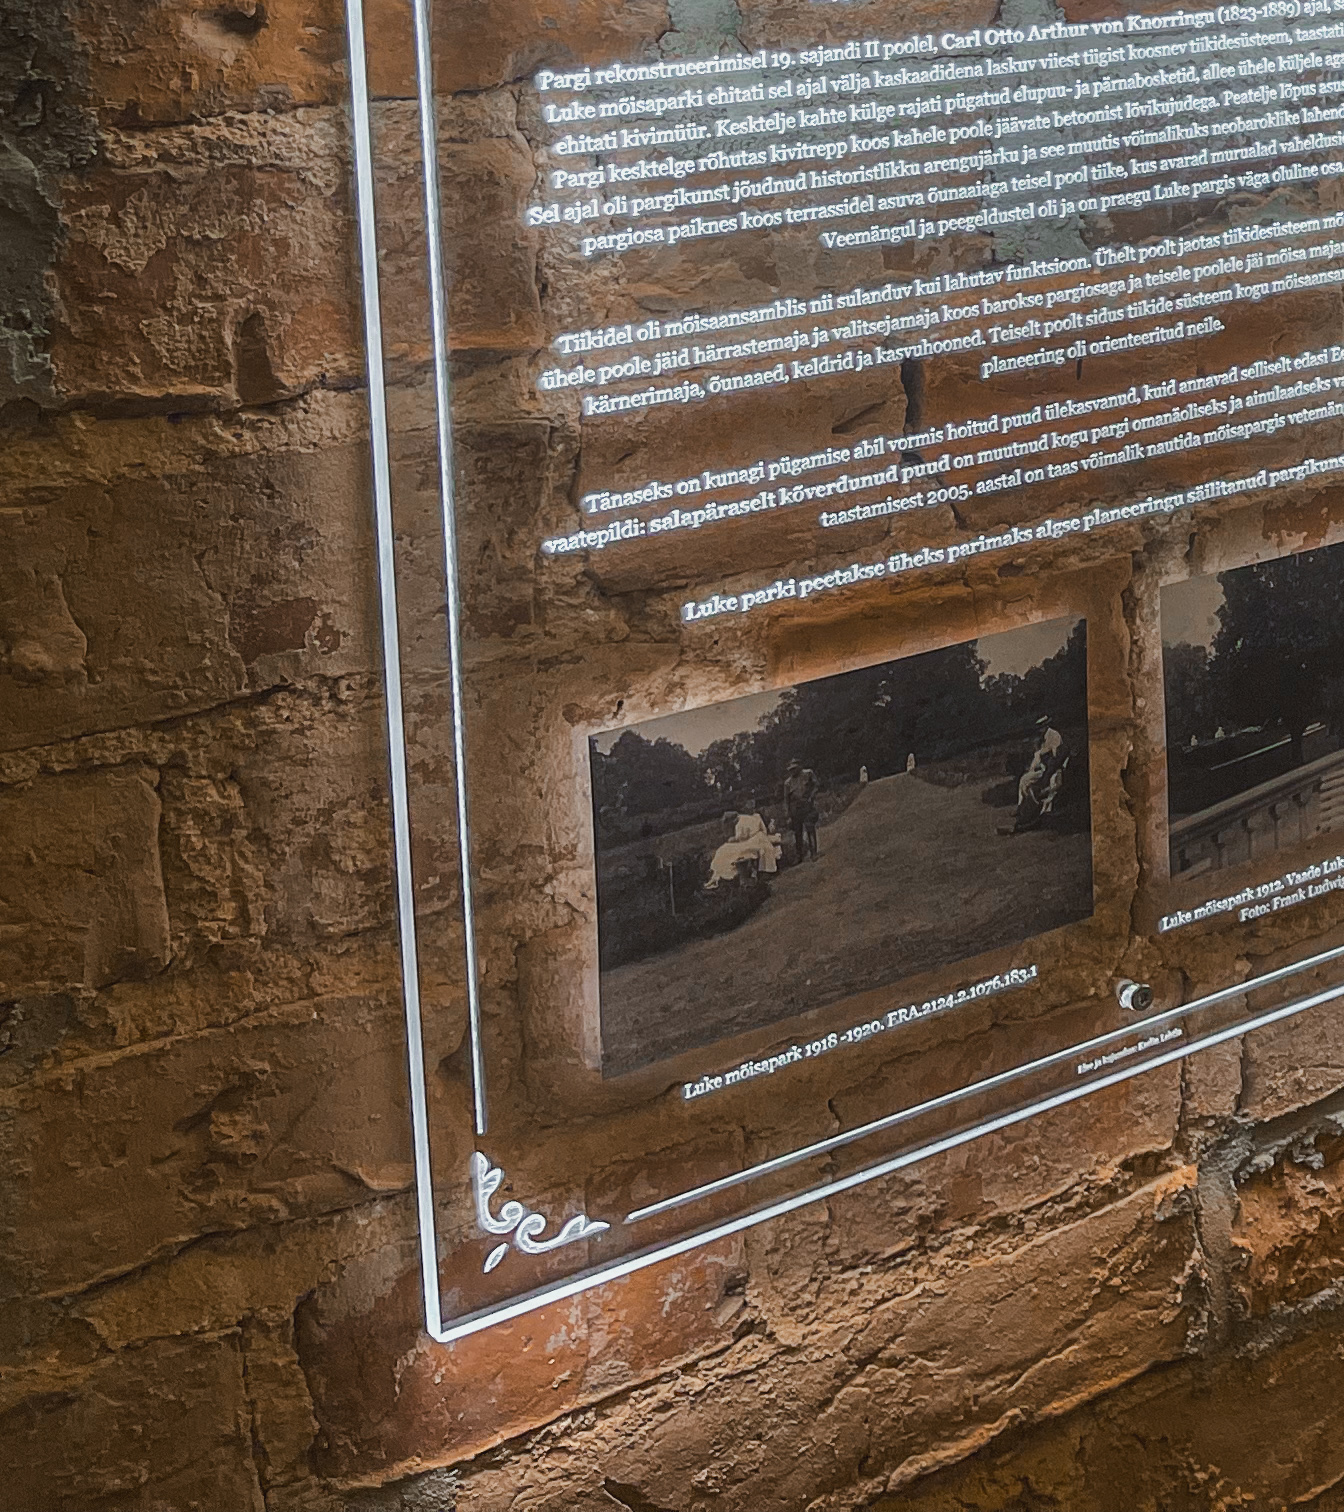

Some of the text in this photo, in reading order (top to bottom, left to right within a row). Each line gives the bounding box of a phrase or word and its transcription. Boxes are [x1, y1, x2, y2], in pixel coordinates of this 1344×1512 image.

[539, 68, 591, 90] Pargi
[594, 50, 767, 84] rekonstrueerimisel
[770, 52, 796, 69] 19.
[799, 42, 861, 66] sajandi
[863, 41, 880, 57] II
[882, 35, 938, 60] poolel,
[941, 30, 981, 49] Carl
[984, 29, 1025, 45] Otto
[1026, 22, 1089, 41] Arthur
[1090, 21, 1124, 34] von
[1126, 10, 1215, 31] Knorringu
[556, 325, 633, 353] Tiikidel
[636, 321, 661, 340] oli
[664, 299, 806, 336] mõisaansamblis
[809, 294, 834, 313] nii
[836, 284, 913, 308] sulanduv
[914, 277, 941, 296] kui
[943, 271, 1004, 291] lahutav
[1005, 258, 1091, 281] funktsioon.
[1094, 246, 1136, 266] Ühelt
[1138, 239, 1176, 263] poolt
[1176, 236, 1220, 256] jaotas
[1222, 220, 1320, 245] tiikidesüsteem
[820, 492, 924, 526] taastamisest
[926, 484, 973, 504] 2005.
[976, 469, 1022, 493] aastal
[1024, 469, 1044, 482] on
[1046, 461, 1078, 477] taas
[1080, 443, 1145, 469] võimalik
[1146, 432, 1201, 456] nautida
[1203, 413, 1285, 444] mõisapargis
[684, 595, 738, 620] Luke
[740, 579, 796, 611] parki
[798, 563, 885, 597] peetakse
[886, 548, 944, 572] üheks
[946, 527, 1033, 563] parimaks
[1036, 518, 1080, 538] algse
[1082, 494, 1184, 531] planeeringu
[1186, 470, 1267, 502] säilitanud
[1162, 911, 1192, 930] Luke
[1193, 887, 1254, 919] mõisapark
[1282, 865, 1321, 888] Vaade
[1240, 903, 1270, 921] Foto:
[1272, 888, 1306, 909] Frank
[684, 1076, 722, 1098] Luke
[724, 1046, 802, 1084] mõisapark
[805, 1033, 837, 1056] 1918
